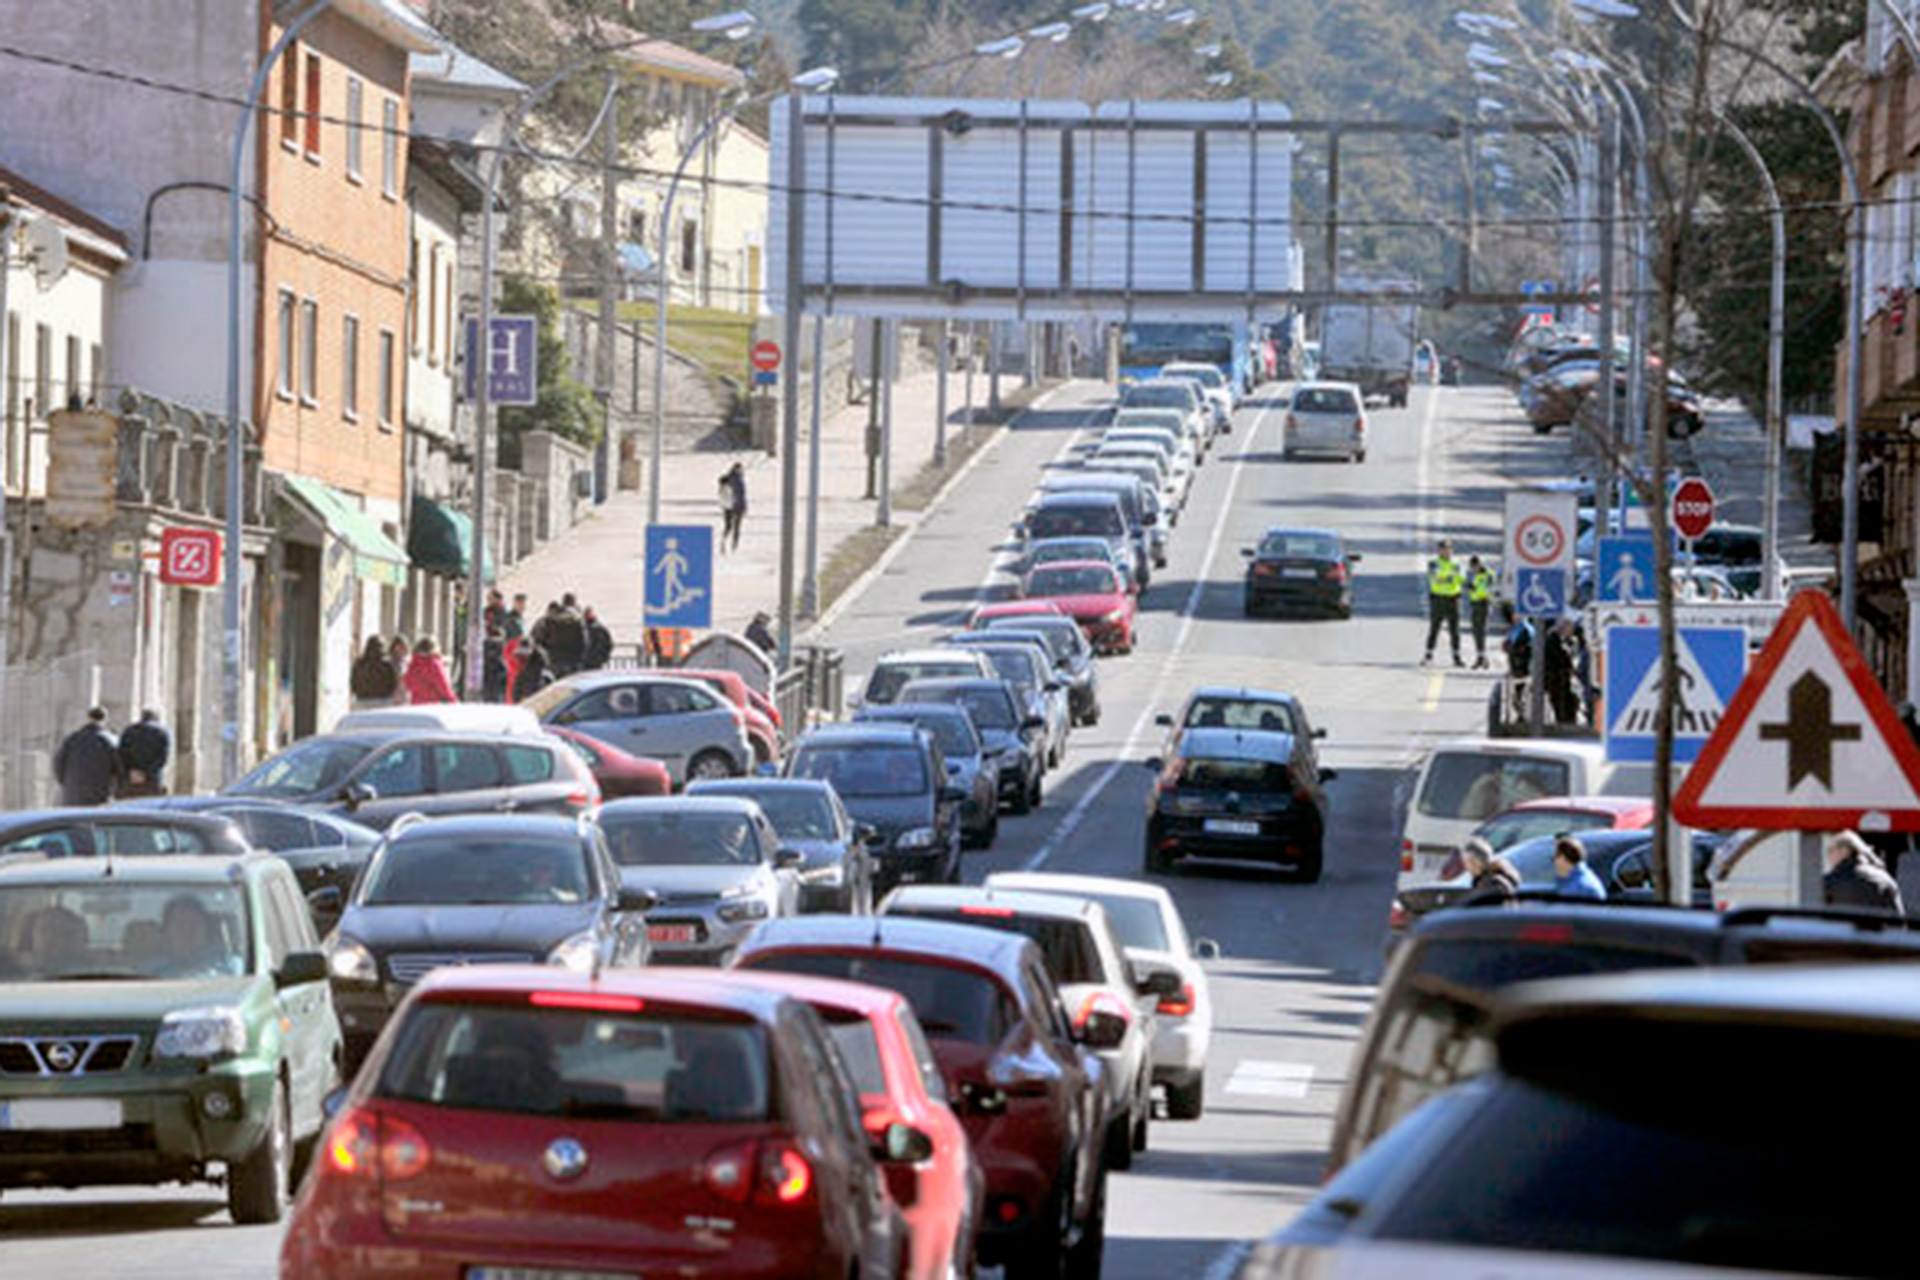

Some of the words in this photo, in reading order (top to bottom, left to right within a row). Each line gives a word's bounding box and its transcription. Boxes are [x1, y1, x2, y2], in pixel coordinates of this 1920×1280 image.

[486, 329, 521, 375] H
[1678, 501, 1709, 517] STOP
[1526, 530, 1555, 550] 50
